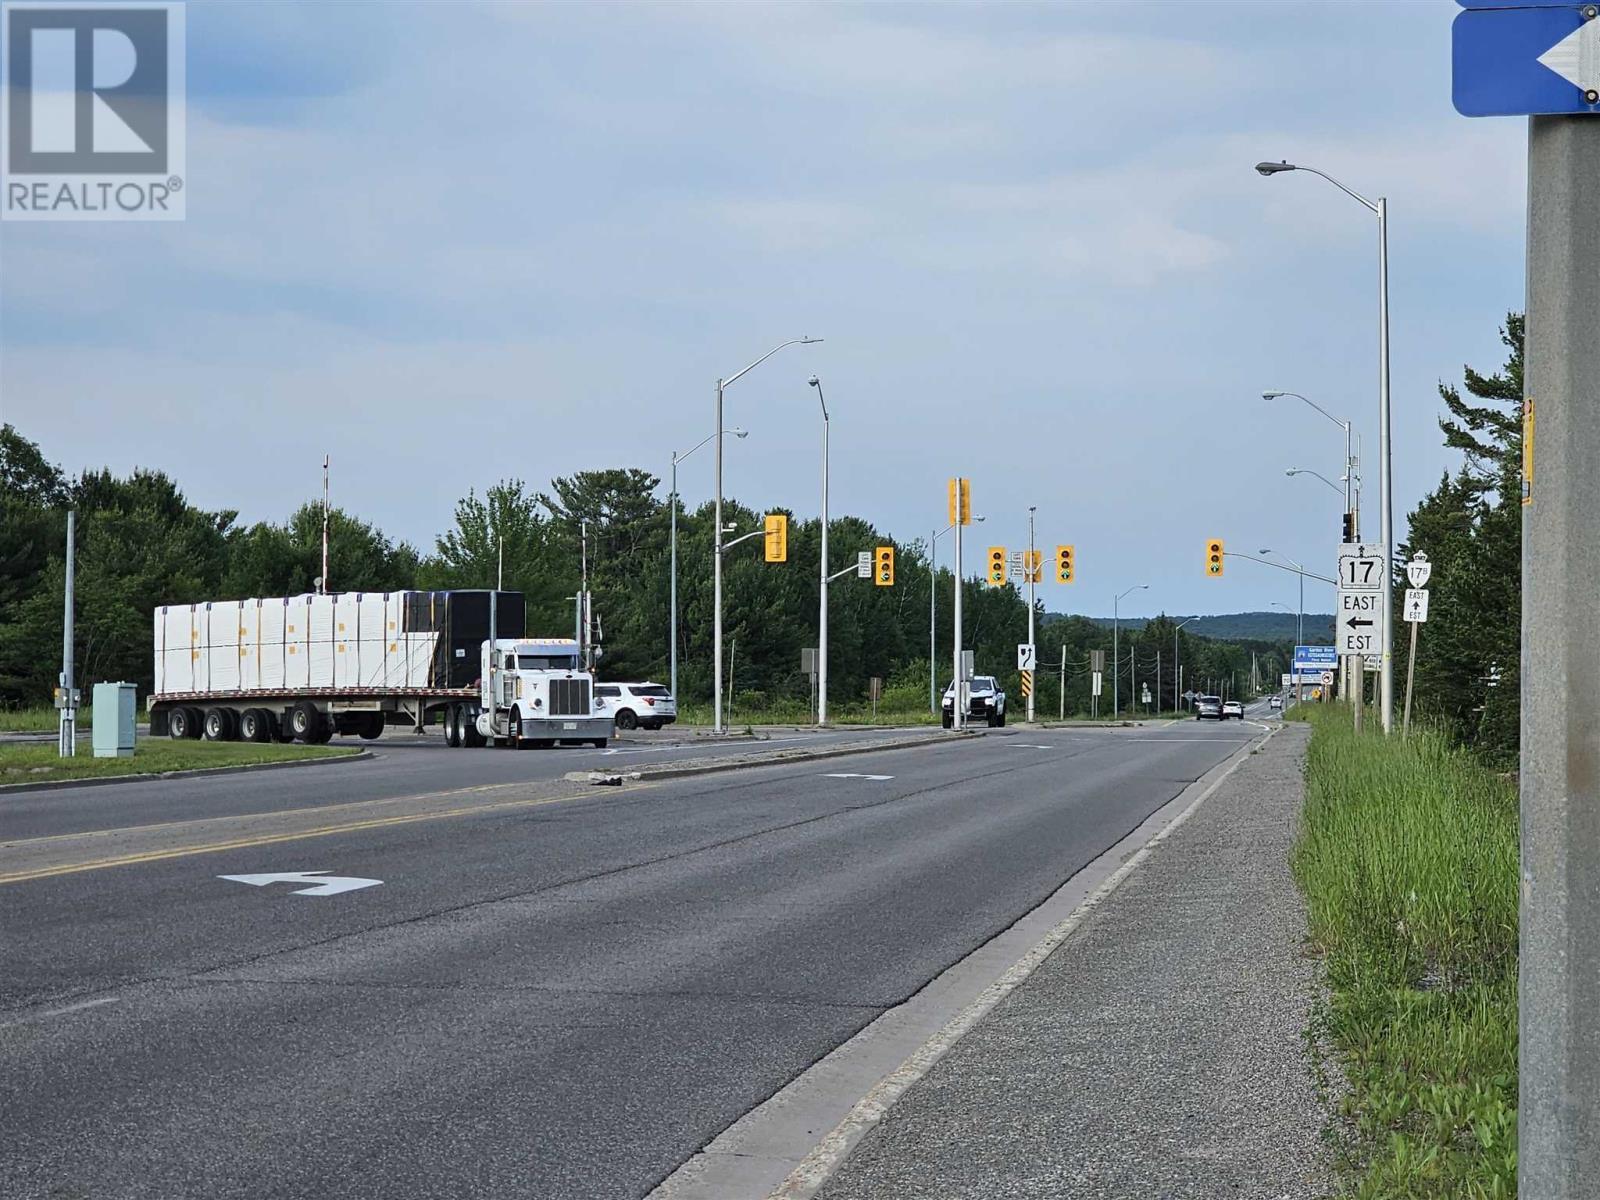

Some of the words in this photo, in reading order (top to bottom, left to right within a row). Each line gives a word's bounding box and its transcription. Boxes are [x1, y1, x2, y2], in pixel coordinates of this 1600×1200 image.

[1349, 561, 1374, 584] 17
[1344, 595, 1377, 610] EAST
[1409, 591, 1425, 600] EAST
[1409, 611, 1421, 619] EST
[1347, 635, 1372, 650] EST
